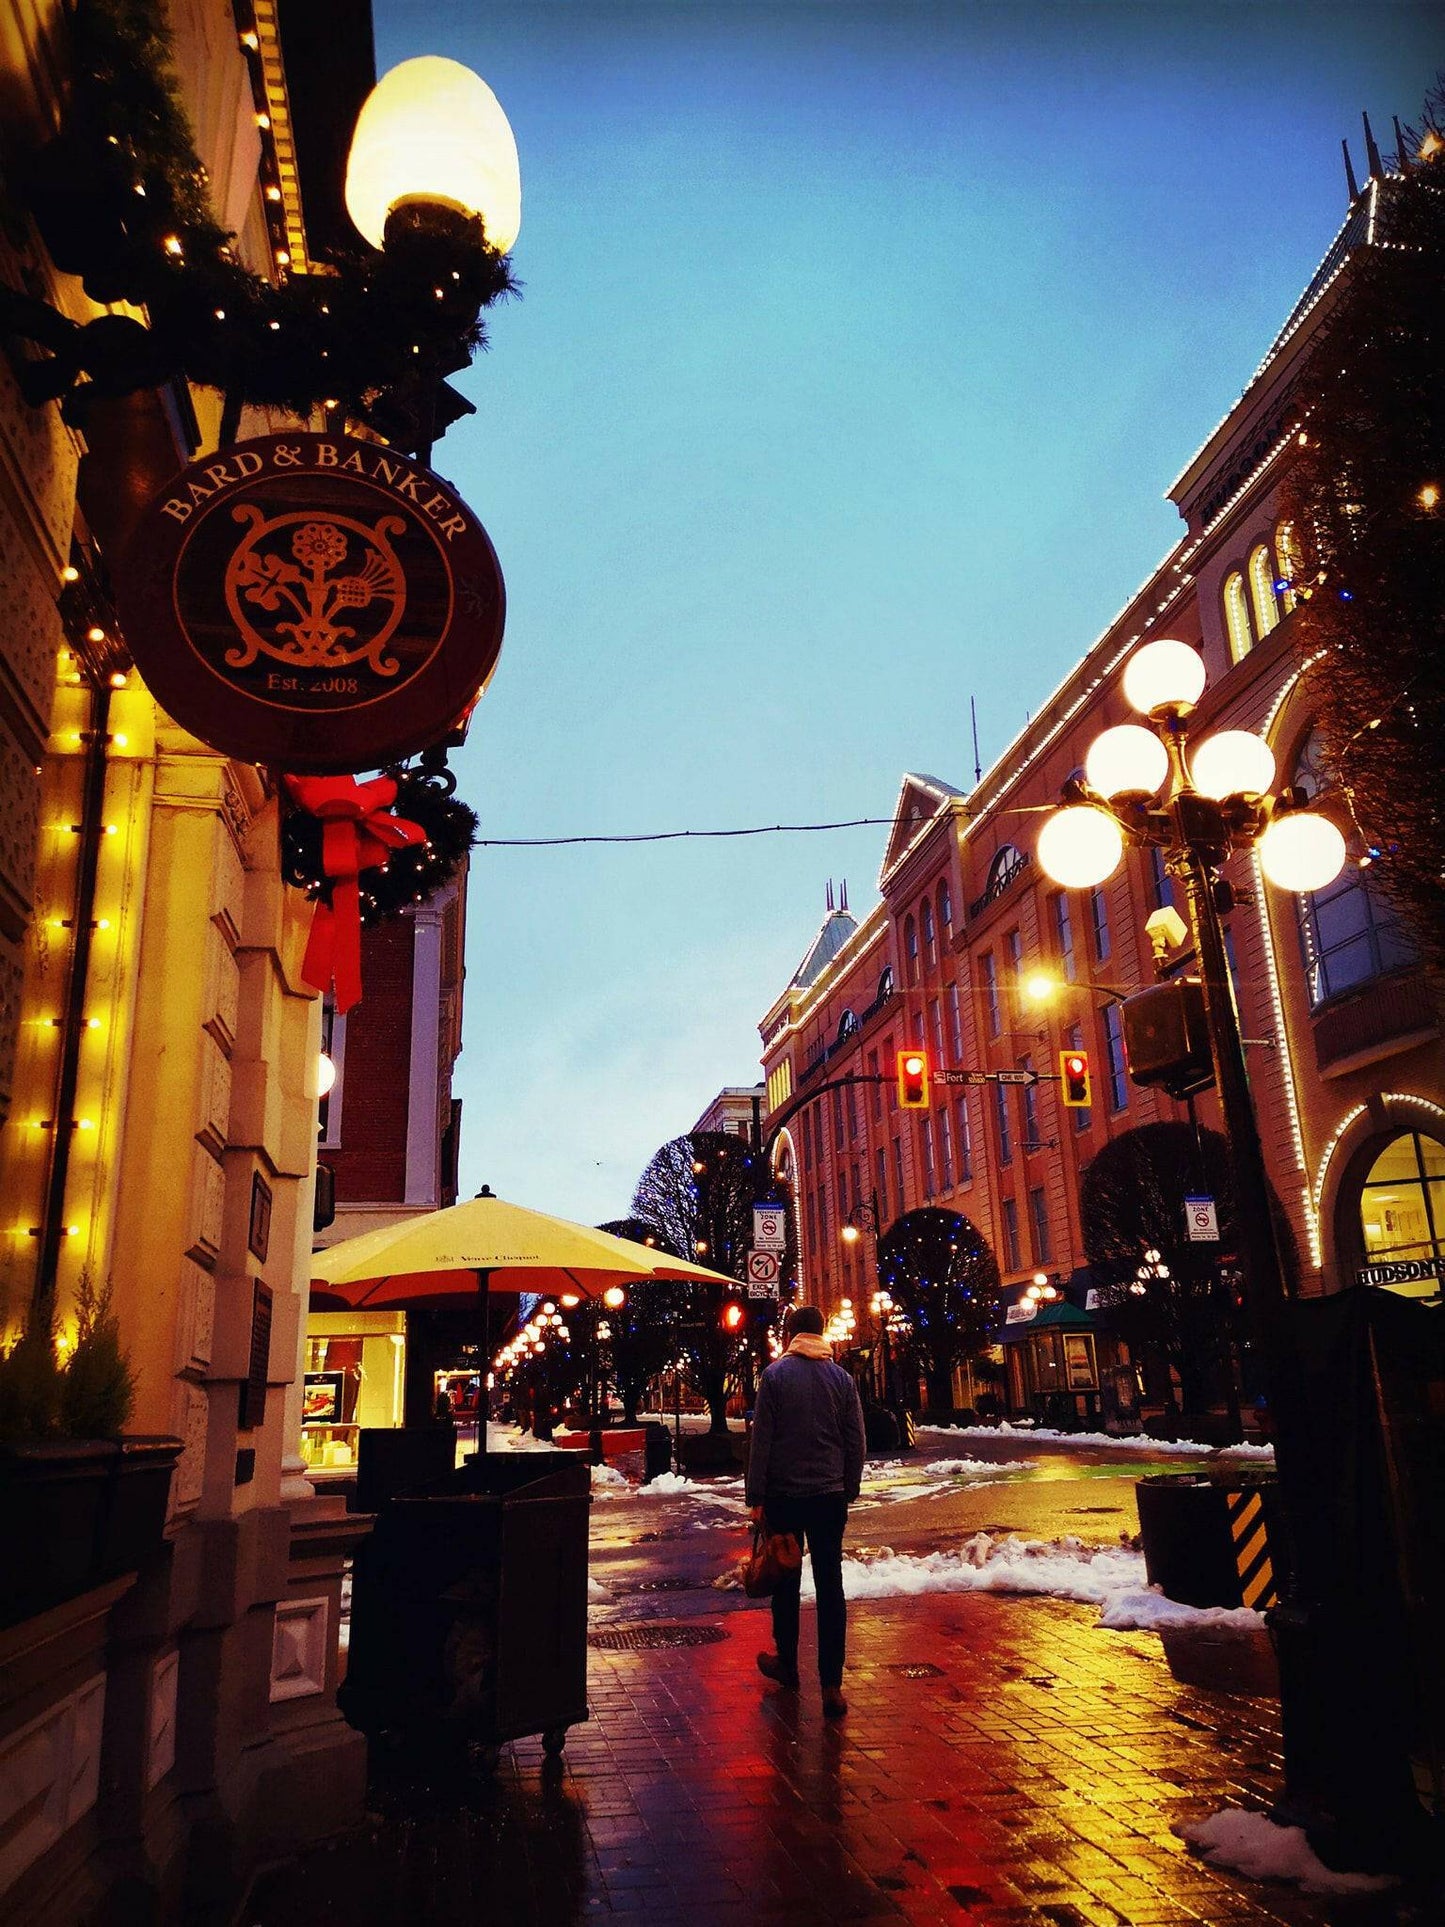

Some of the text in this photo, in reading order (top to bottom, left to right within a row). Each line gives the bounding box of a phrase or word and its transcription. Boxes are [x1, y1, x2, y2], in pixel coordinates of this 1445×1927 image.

[161, 443, 466, 542] BARD & BANKER
[267, 673, 358, 693] Est. 2008
[946, 1072, 963, 1082] Fort
